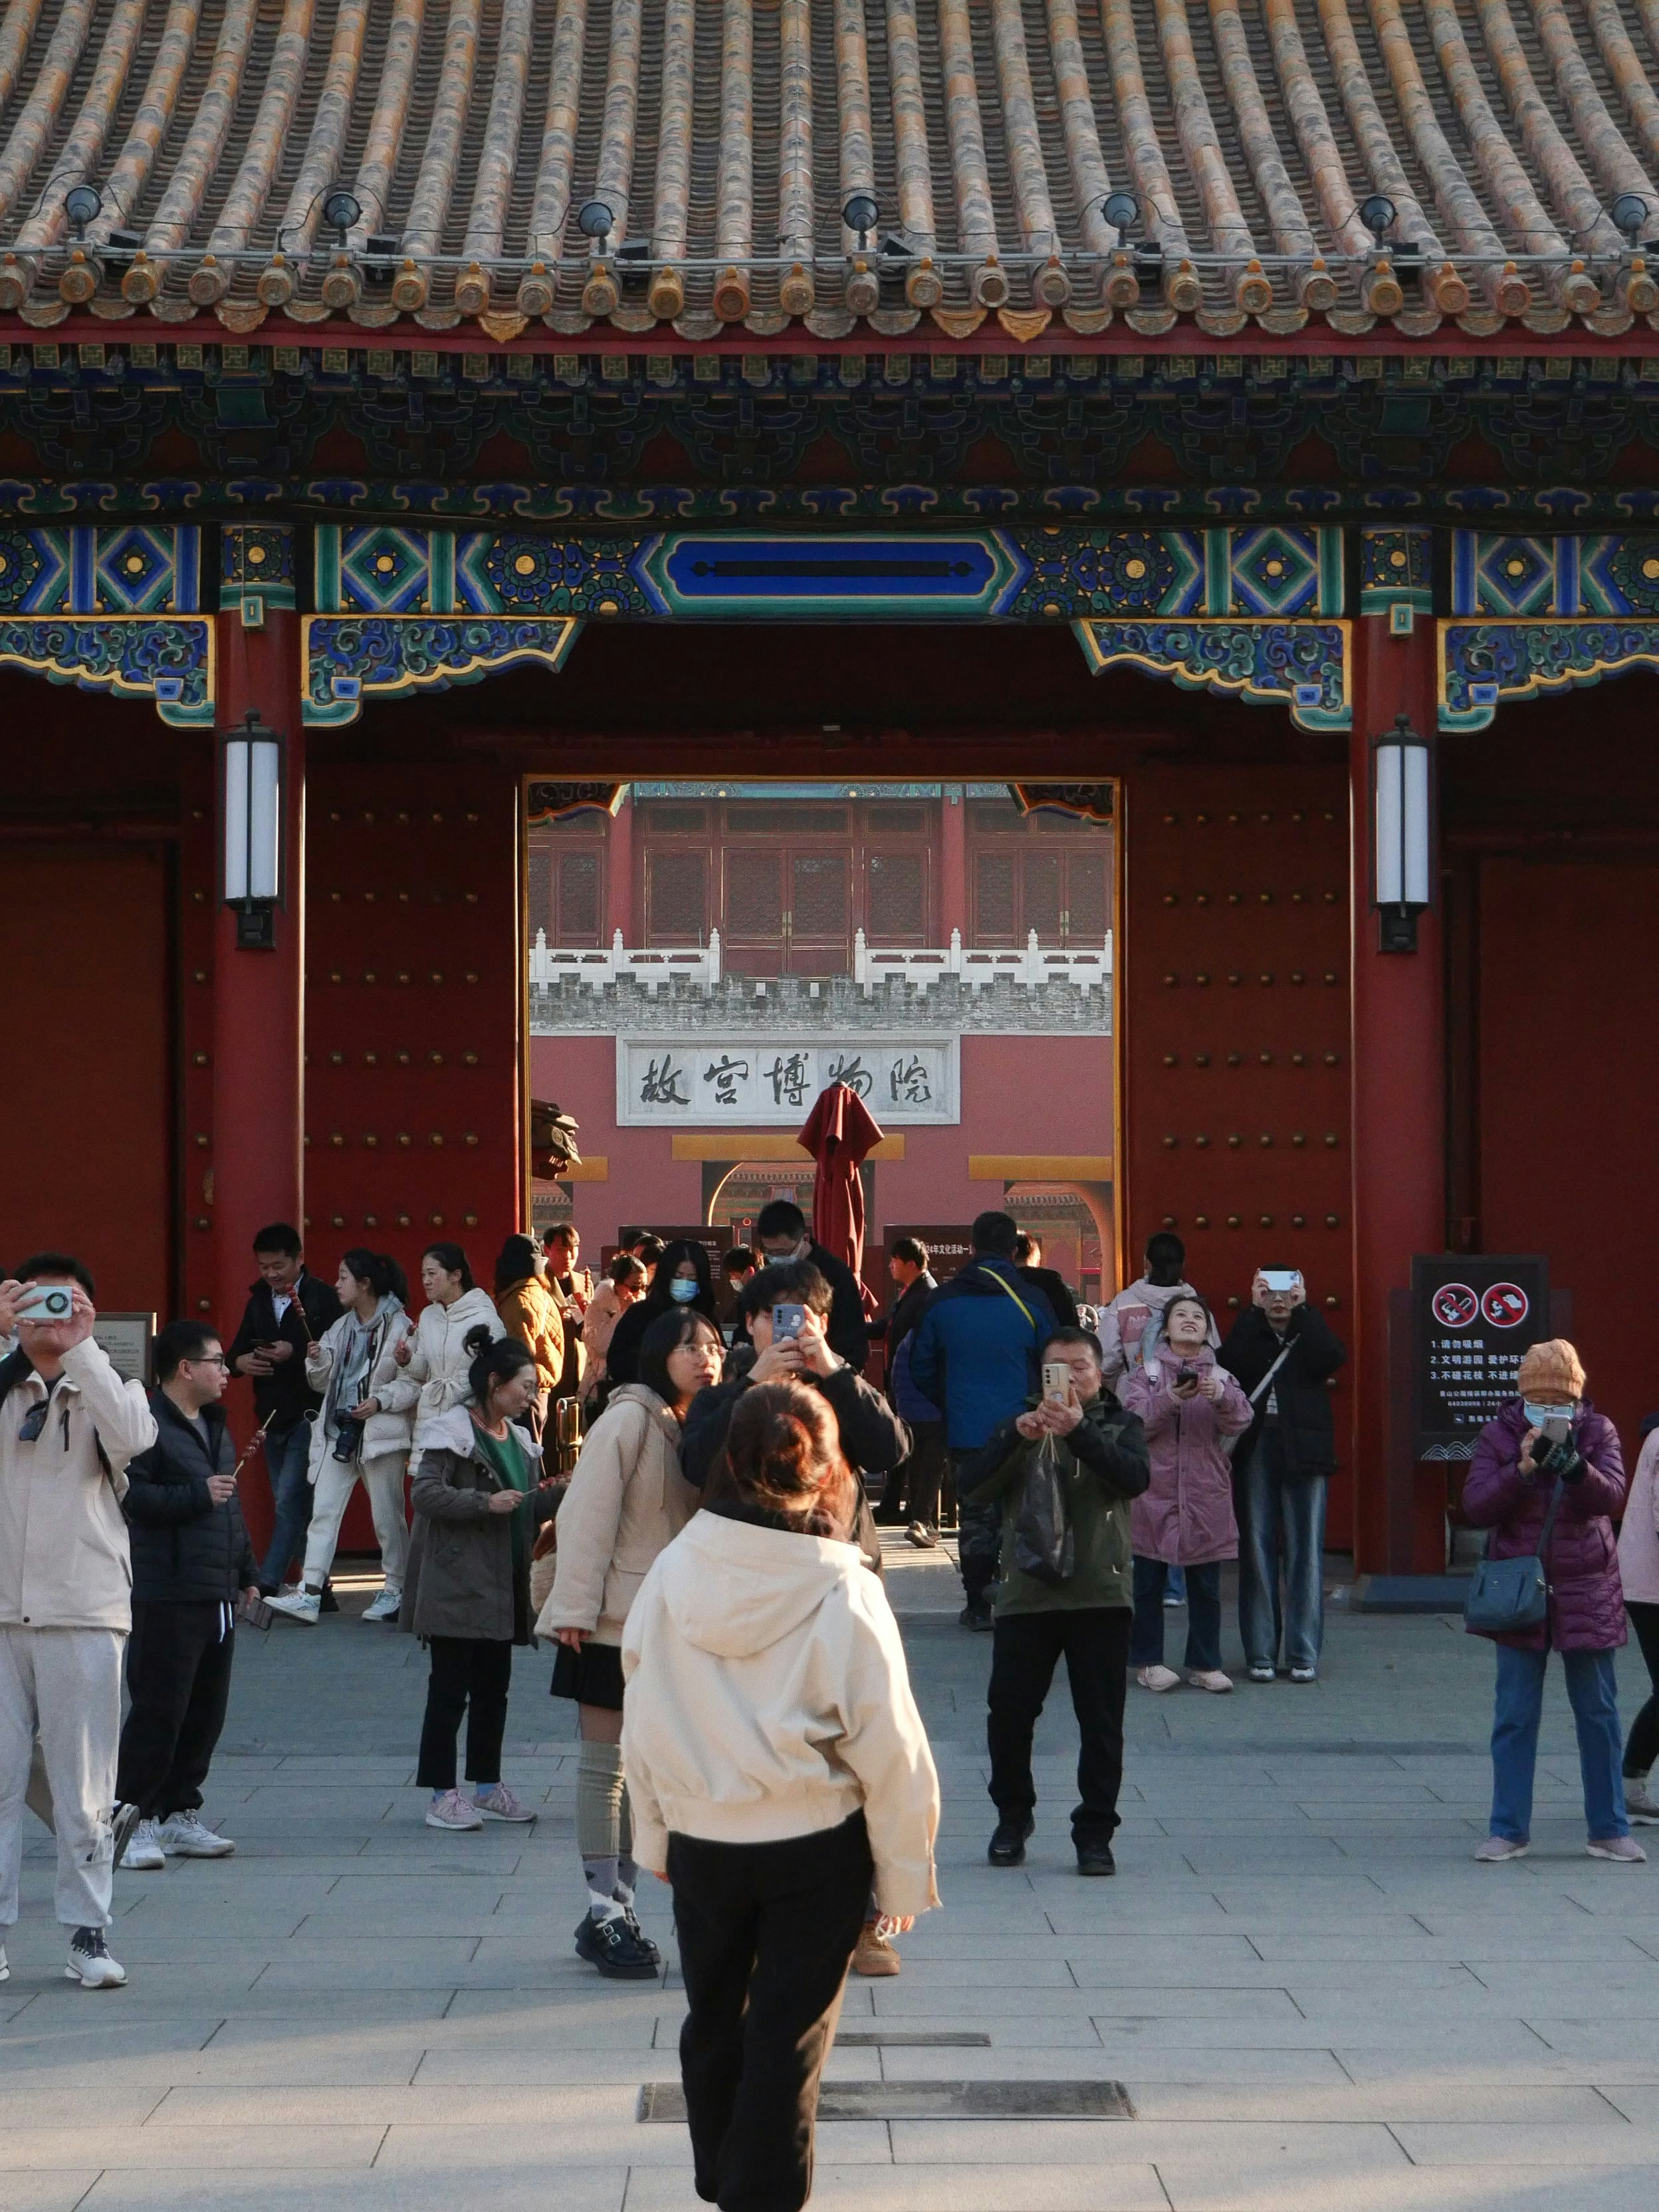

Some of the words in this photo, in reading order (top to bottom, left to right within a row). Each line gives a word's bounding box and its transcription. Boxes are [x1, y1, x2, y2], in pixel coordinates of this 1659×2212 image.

[639, 1052, 933, 1107] 故宫博物院
[1430, 1339, 1484, 1349] 1.请勿吸烟
[1430, 1355, 1483, 1364] 2.文明游园
